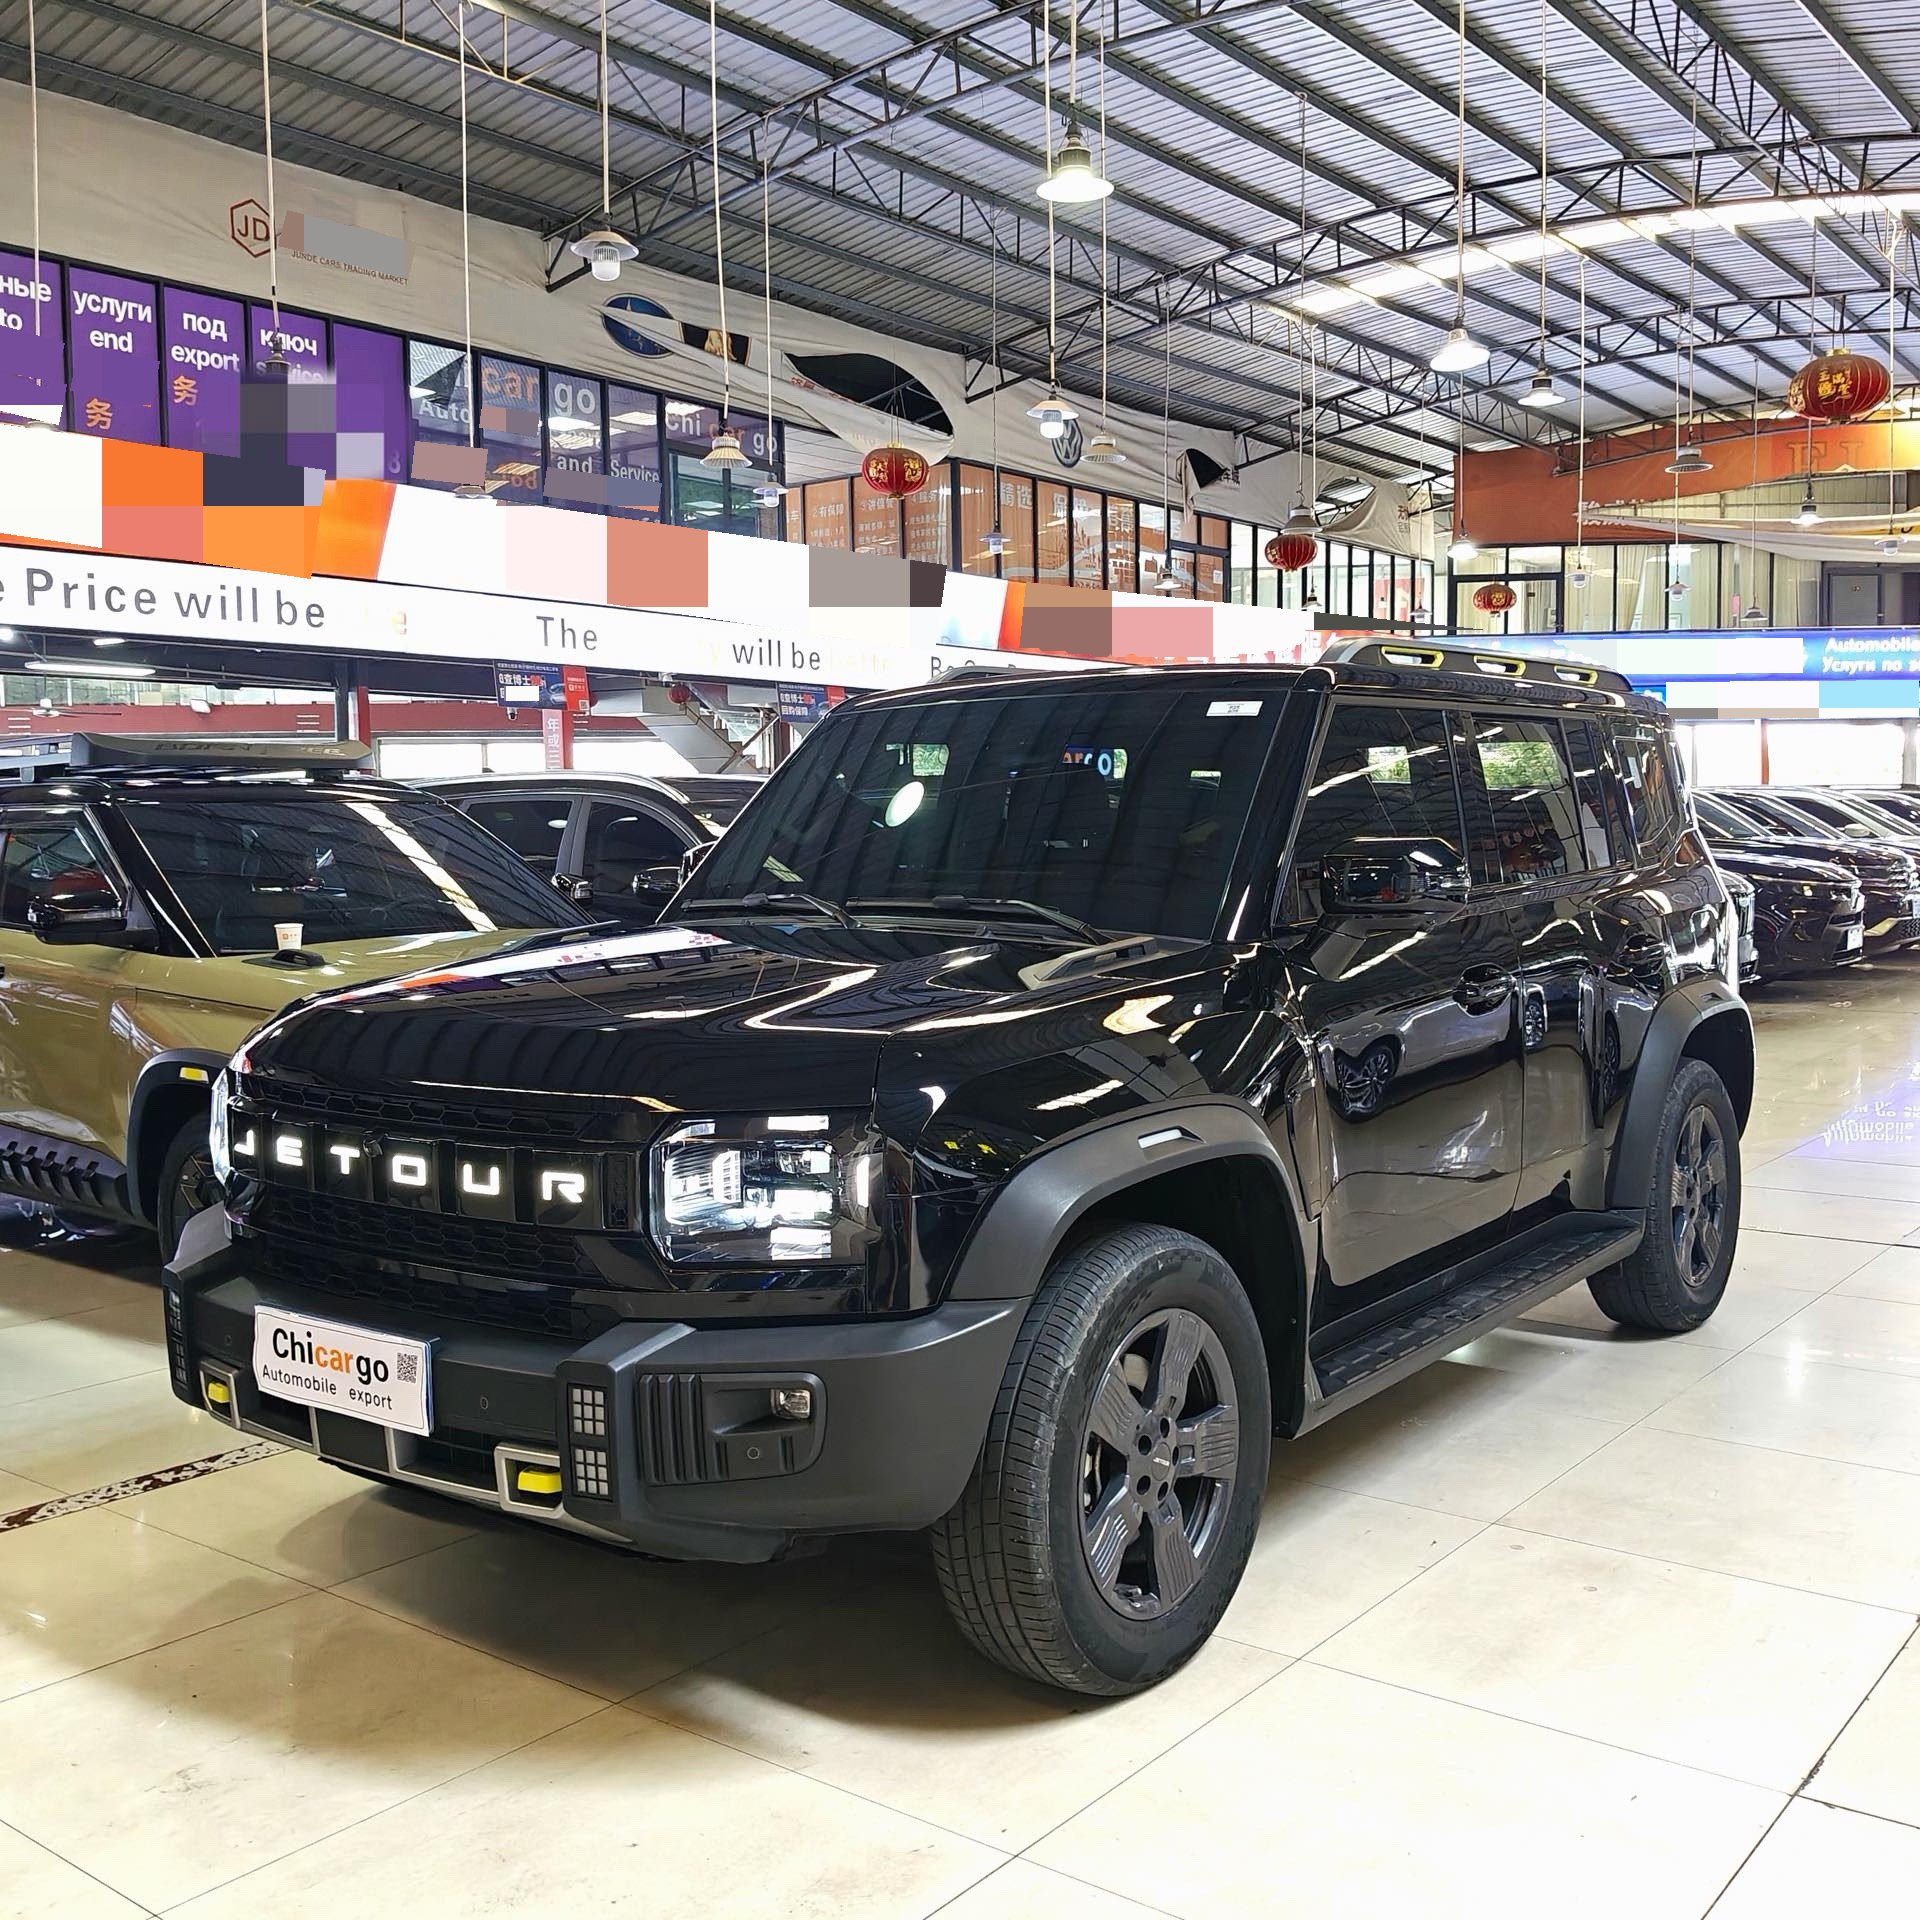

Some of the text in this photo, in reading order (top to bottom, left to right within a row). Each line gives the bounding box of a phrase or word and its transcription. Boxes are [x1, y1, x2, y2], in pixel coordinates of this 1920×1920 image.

[236, 214, 271, 242] JD
[73, 290, 152, 323] услуги
[182, 312, 228, 343] под
[89, 329, 133, 353] end
[171, 344, 240, 372] export
[554, 381, 596, 417] go
[26, 568, 156, 614] Price
[174, 585, 258, 623] will
[276, 589, 325, 628] be
[536, 615, 598, 650] The
[732, 638, 781, 667] will
[791, 641, 821, 670] be
[235, 1130, 585, 1203] JETOUR
[272, 1328, 389, 1385] Chicargo
[263, 1364, 392, 1411] Automobile export
